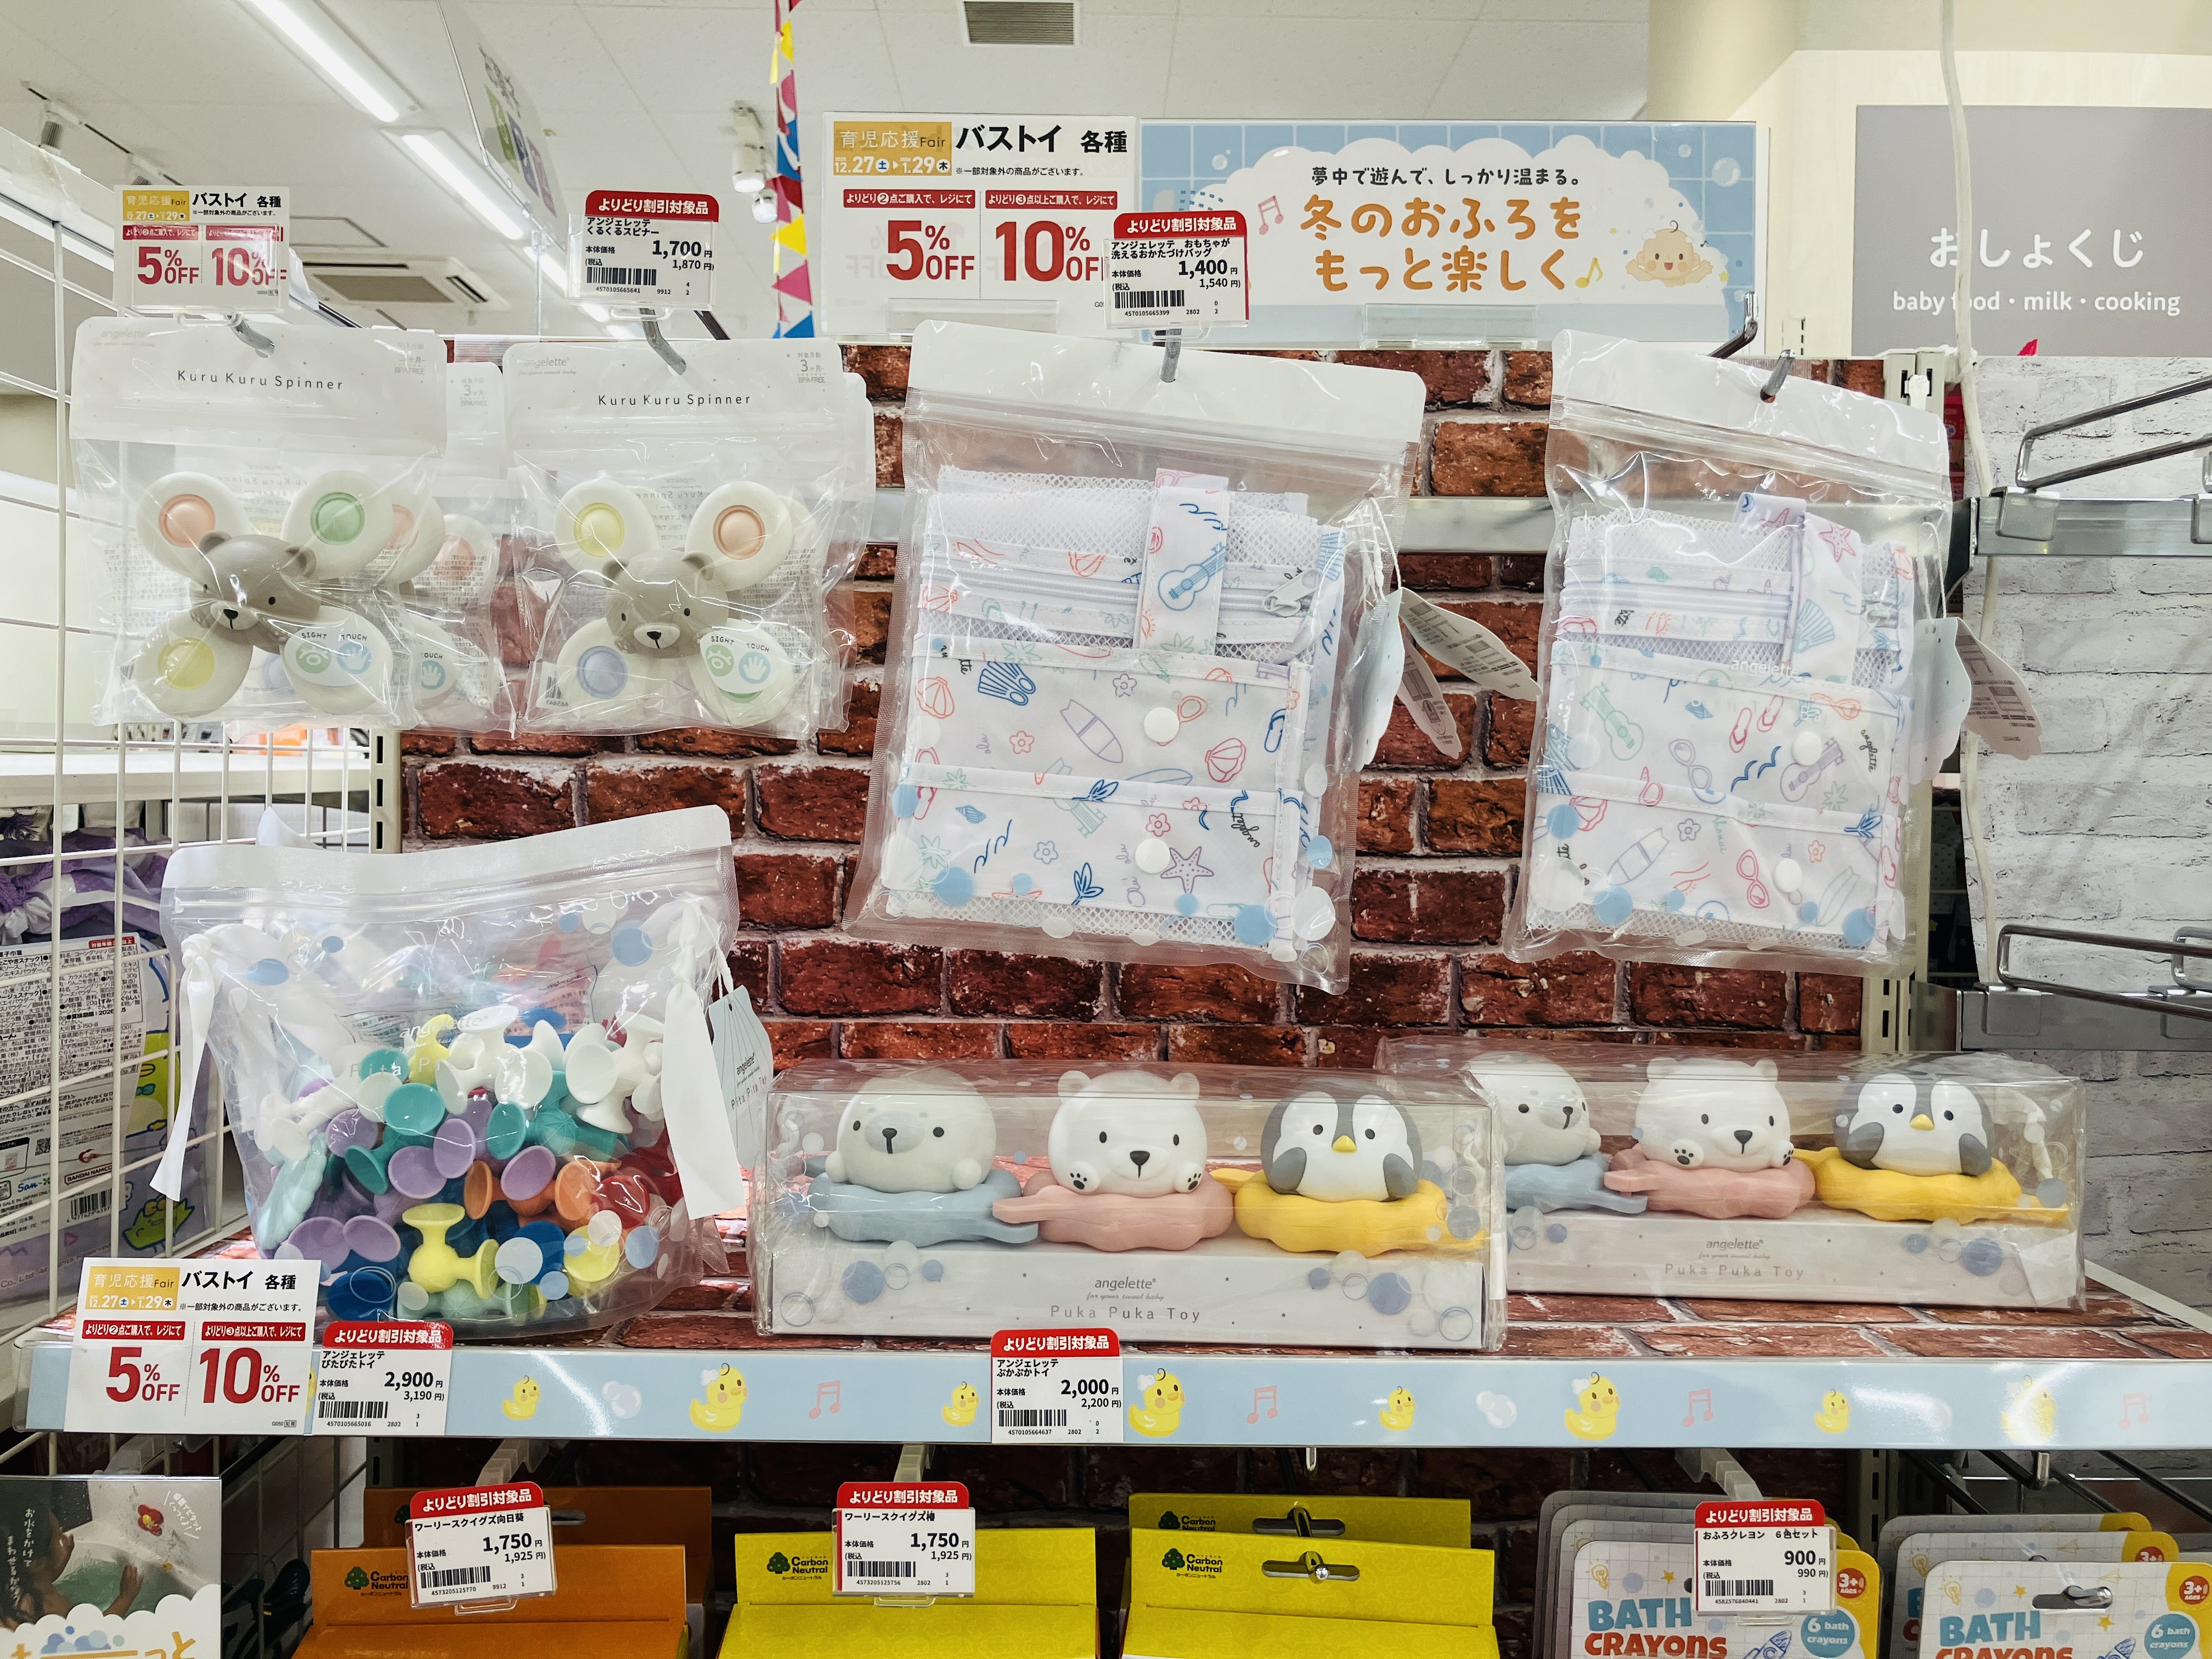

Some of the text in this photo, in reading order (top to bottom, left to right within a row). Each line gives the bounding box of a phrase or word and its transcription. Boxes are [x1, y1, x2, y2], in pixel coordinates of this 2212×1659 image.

[840, 125, 1127, 153] 育児応援Fair バストイ 各種
[956, 167, 1083, 176] ※一部対象外の商品がございます。
[1312, 167, 1581, 187] 夢中で遊んで、しっかり温まる。
[193, 193, 247, 207] バストイ
[257, 196, 281, 208] 各種
[599, 198, 708, 215] よりどり割引対象品
[587, 217, 651, 228] アンジェレッテ
[1300, 194, 1581, 240] 冬のおふろを
[587, 226, 659, 236] くるくるスピナー
[1127, 217, 1236, 233] よりどり割引対象品
[585, 245, 616, 254] 本体価格
[652, 240, 702, 259] 1,700
[1111, 238, 1230, 250] アンジェレッテ おもちゃが
[1930, 227, 2143, 269] おしょくじ
[1111, 247, 1211, 259] 洗えるおかたづけバッグ
[672, 259, 701, 270] 1,870
[926, 256, 974, 280] OFF
[1179, 259, 1227, 279] 1,400
[1316, 247, 1565, 293] もっと楽しく
[165, 267, 199, 284] OFF
[1199, 278, 1228, 289] 1,540
[1893, 290, 2181, 316] baby fod milk cooking
[178, 370, 342, 391] Kuru Kuru Spinner
[598, 393, 751, 407] Kuru Kuru Spinner
[301, 631, 367, 642] SIGHT TOUCH
[710, 635, 769, 653] SIGHT TOUCH
[67, 1172, 89, 1181] BANDAI
[1665, 1263, 1803, 1280] Puka Puka Toy
[94, 1271, 296, 1290] 育児応援Fair バストイ 各種
[180, 1303, 302, 1312] ※一部対象外の商品がございます。
[1051, 1305, 1200, 1323] Puka Puka Toy
[335, 1329, 442, 1344] よりどり割引対象品
[1003, 1335, 1109, 1351] よりどり割引対象品
[323, 1351, 385, 1359] アンジェレッテ
[997, 1359, 1059, 1368] アンジェレッテ
[997, 1368, 1049, 1377] ぷかぷかトイ
[384, 1372, 433, 1391] 2,900
[1061, 1379, 1109, 1398] 2,000
[142, 1384, 180, 1401] OFF
[261, 1385, 300, 1403] OFF
[404, 1391, 432, 1402] 3,190
[1081, 1398, 1109, 1409] 2,200
[423, 1488, 532, 1511] よりどり割引対象品
[850, 1489, 957, 1503] よりどり割引対象品
[415, 1513, 524, 1531] ワーリースクイグズ向日葵
[1181, 1515, 1216, 1525] Carbon
[1706, 1508, 1813, 1523] よりどり割引対象品
[911, 1533, 959, 1551] 1,750
[1703, 1531, 1765, 1539] おふろクレヨン
[416, 1549, 446, 1559] 本体価格
[483, 1533, 532, 1554] 1,750
[505, 1551, 533, 1563] 1,925
[791, 1556, 828, 1566] Carbon
[931, 1551, 958, 1562] 1,925
[1186, 1554, 1223, 1565] Carbon
[1785, 1550, 1816, 1565] 900
[370, 1571, 408, 1581] Carbon
[1187, 1564, 1222, 1573] Neutral
[1798, 1569, 1815, 1577] 990
[1839, 1573, 1858, 1588] 3+
[2184, 1581, 2202, 1595] 3+
[432, 1587, 476, 1595] 4573205125770
[1588, 1597, 1692, 1631] BATH
[1808, 1617, 1849, 1633] 6 bath
[1940, 1610, 2040, 1646] BATH
[2151, 1624, 2163, 1639] 6
[1807, 1637, 1848, 1645] crayons
